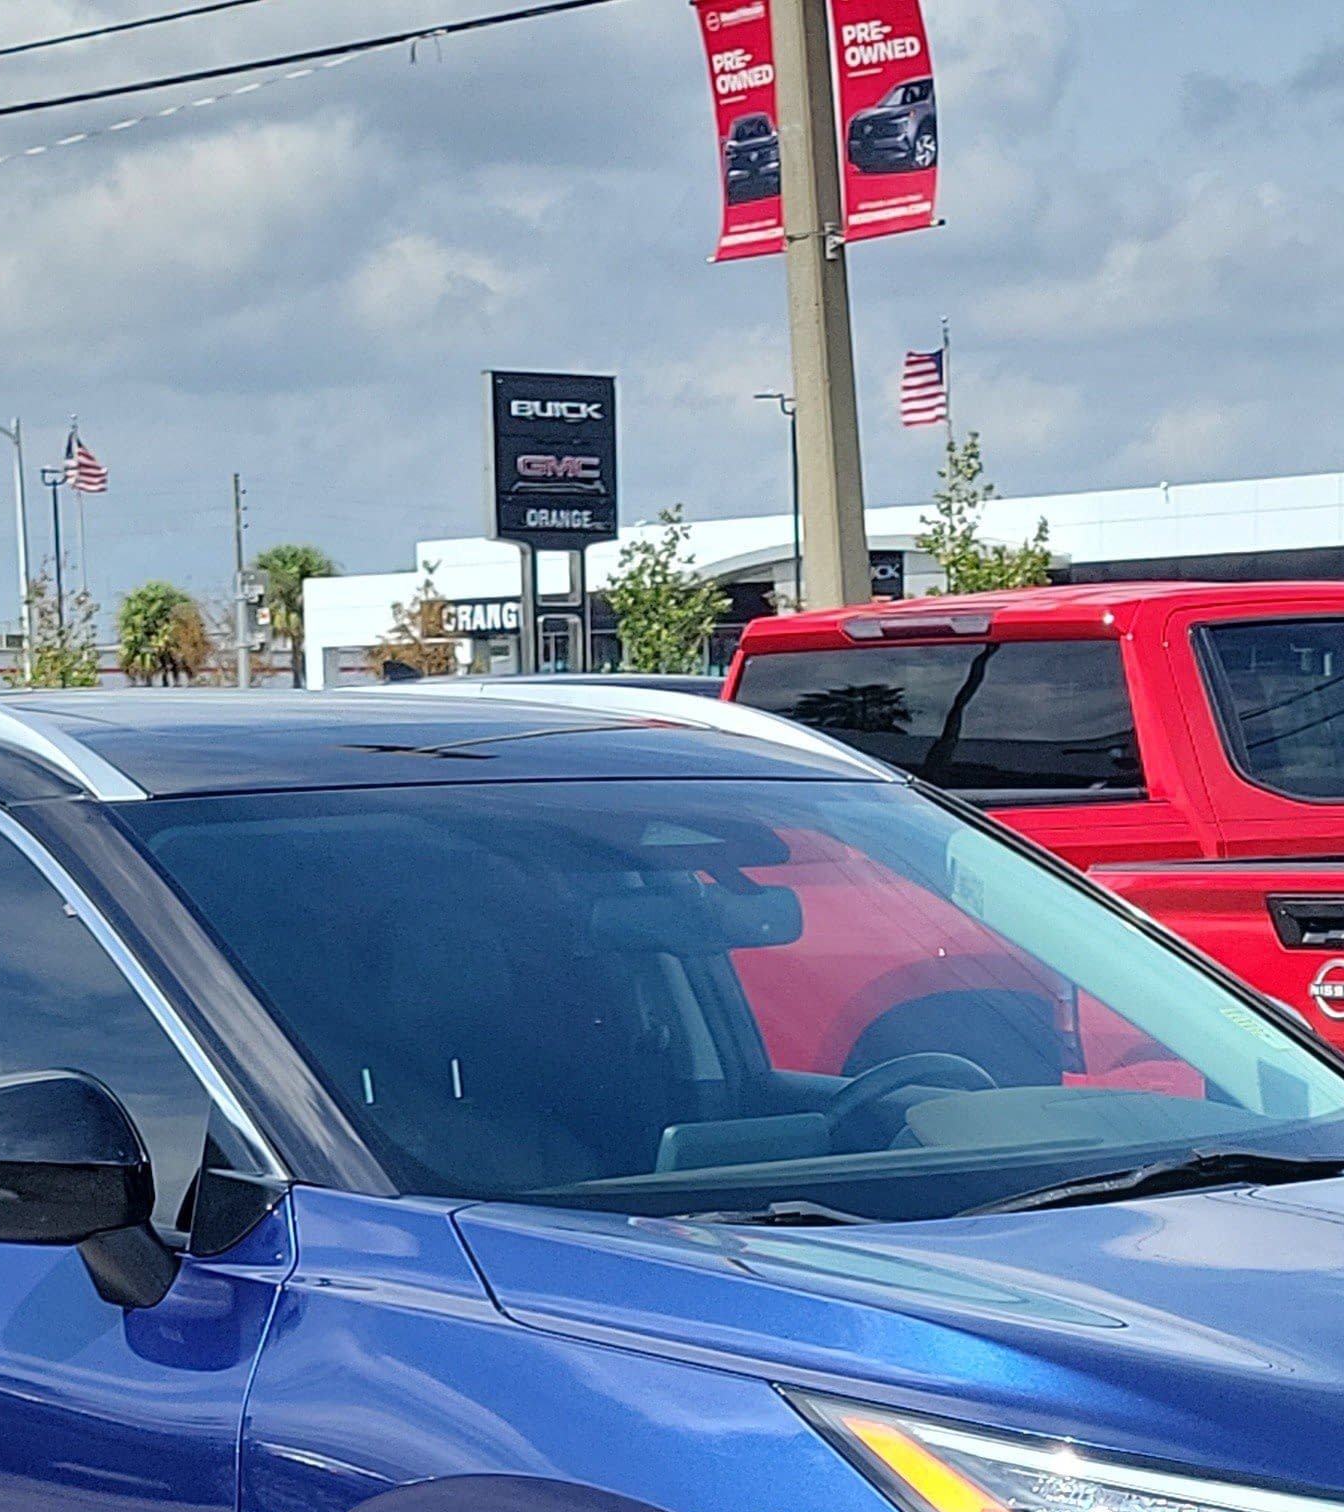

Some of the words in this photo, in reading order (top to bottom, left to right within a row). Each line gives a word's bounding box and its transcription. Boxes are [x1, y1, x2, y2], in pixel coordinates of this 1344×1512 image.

[841, 20, 893, 46] PRE-
[711, 48, 753, 74] PRE-
[844, 36, 921, 68] OWNED
[715, 63, 775, 95] OWNED
[510, 400, 604, 419] BUICK
[516, 454, 601, 478] GMC
[525, 508, 593, 528] ORANGE
[442, 602, 520, 631] ORANG
